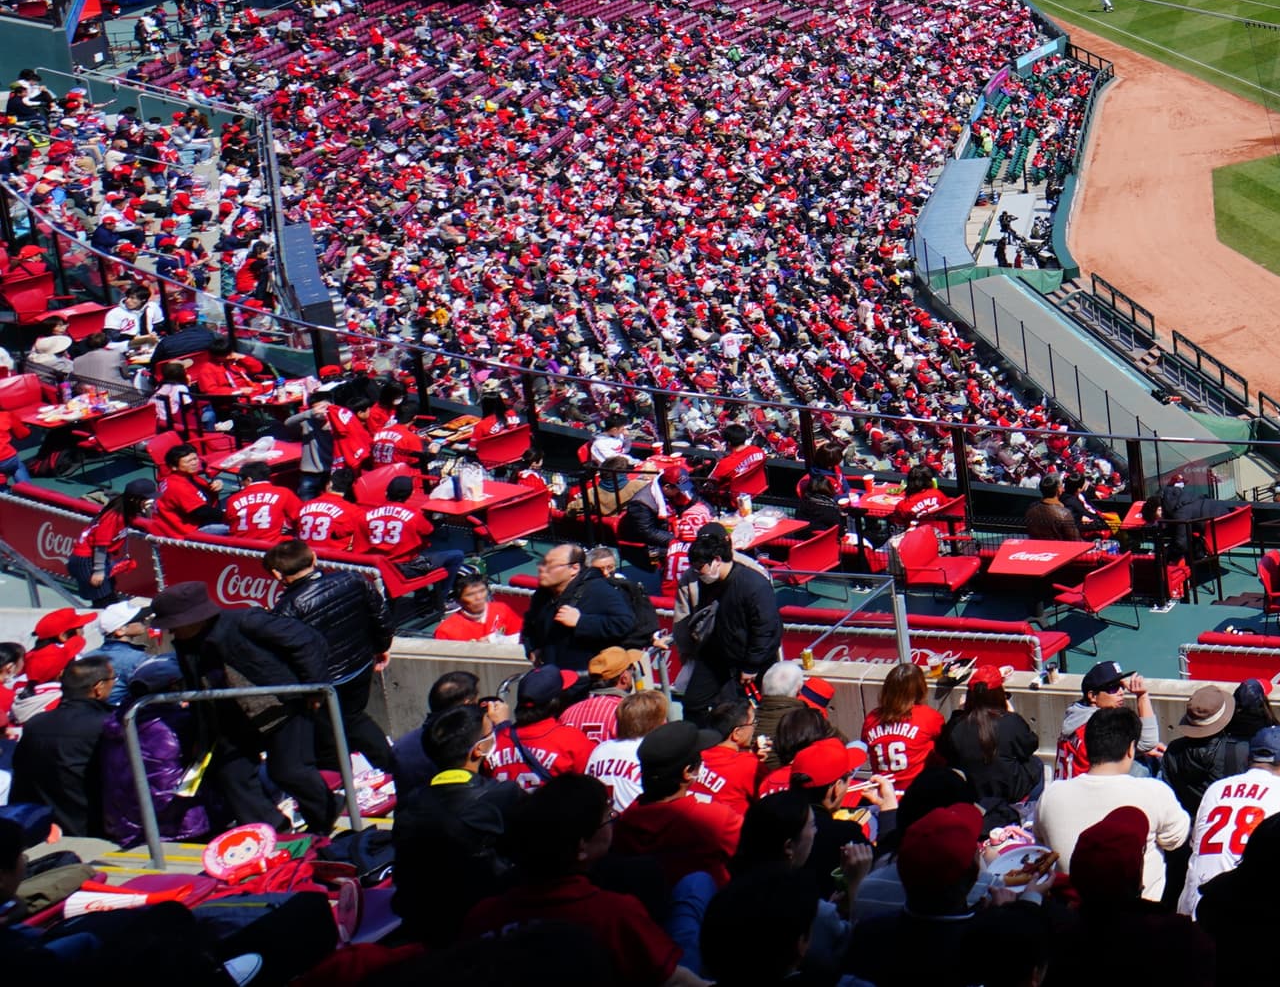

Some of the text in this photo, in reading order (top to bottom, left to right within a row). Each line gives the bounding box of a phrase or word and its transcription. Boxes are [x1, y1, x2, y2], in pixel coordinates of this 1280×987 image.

[236, 504, 272, 532] 14
[366, 503, 413, 521] KIKUCHI
[300, 515, 332, 542] 33
[368, 519, 404, 546] 33
[873, 741, 908, 772] 16
[1220, 782, 1268, 802] ARAI
[1200, 804, 1267, 856] 28
